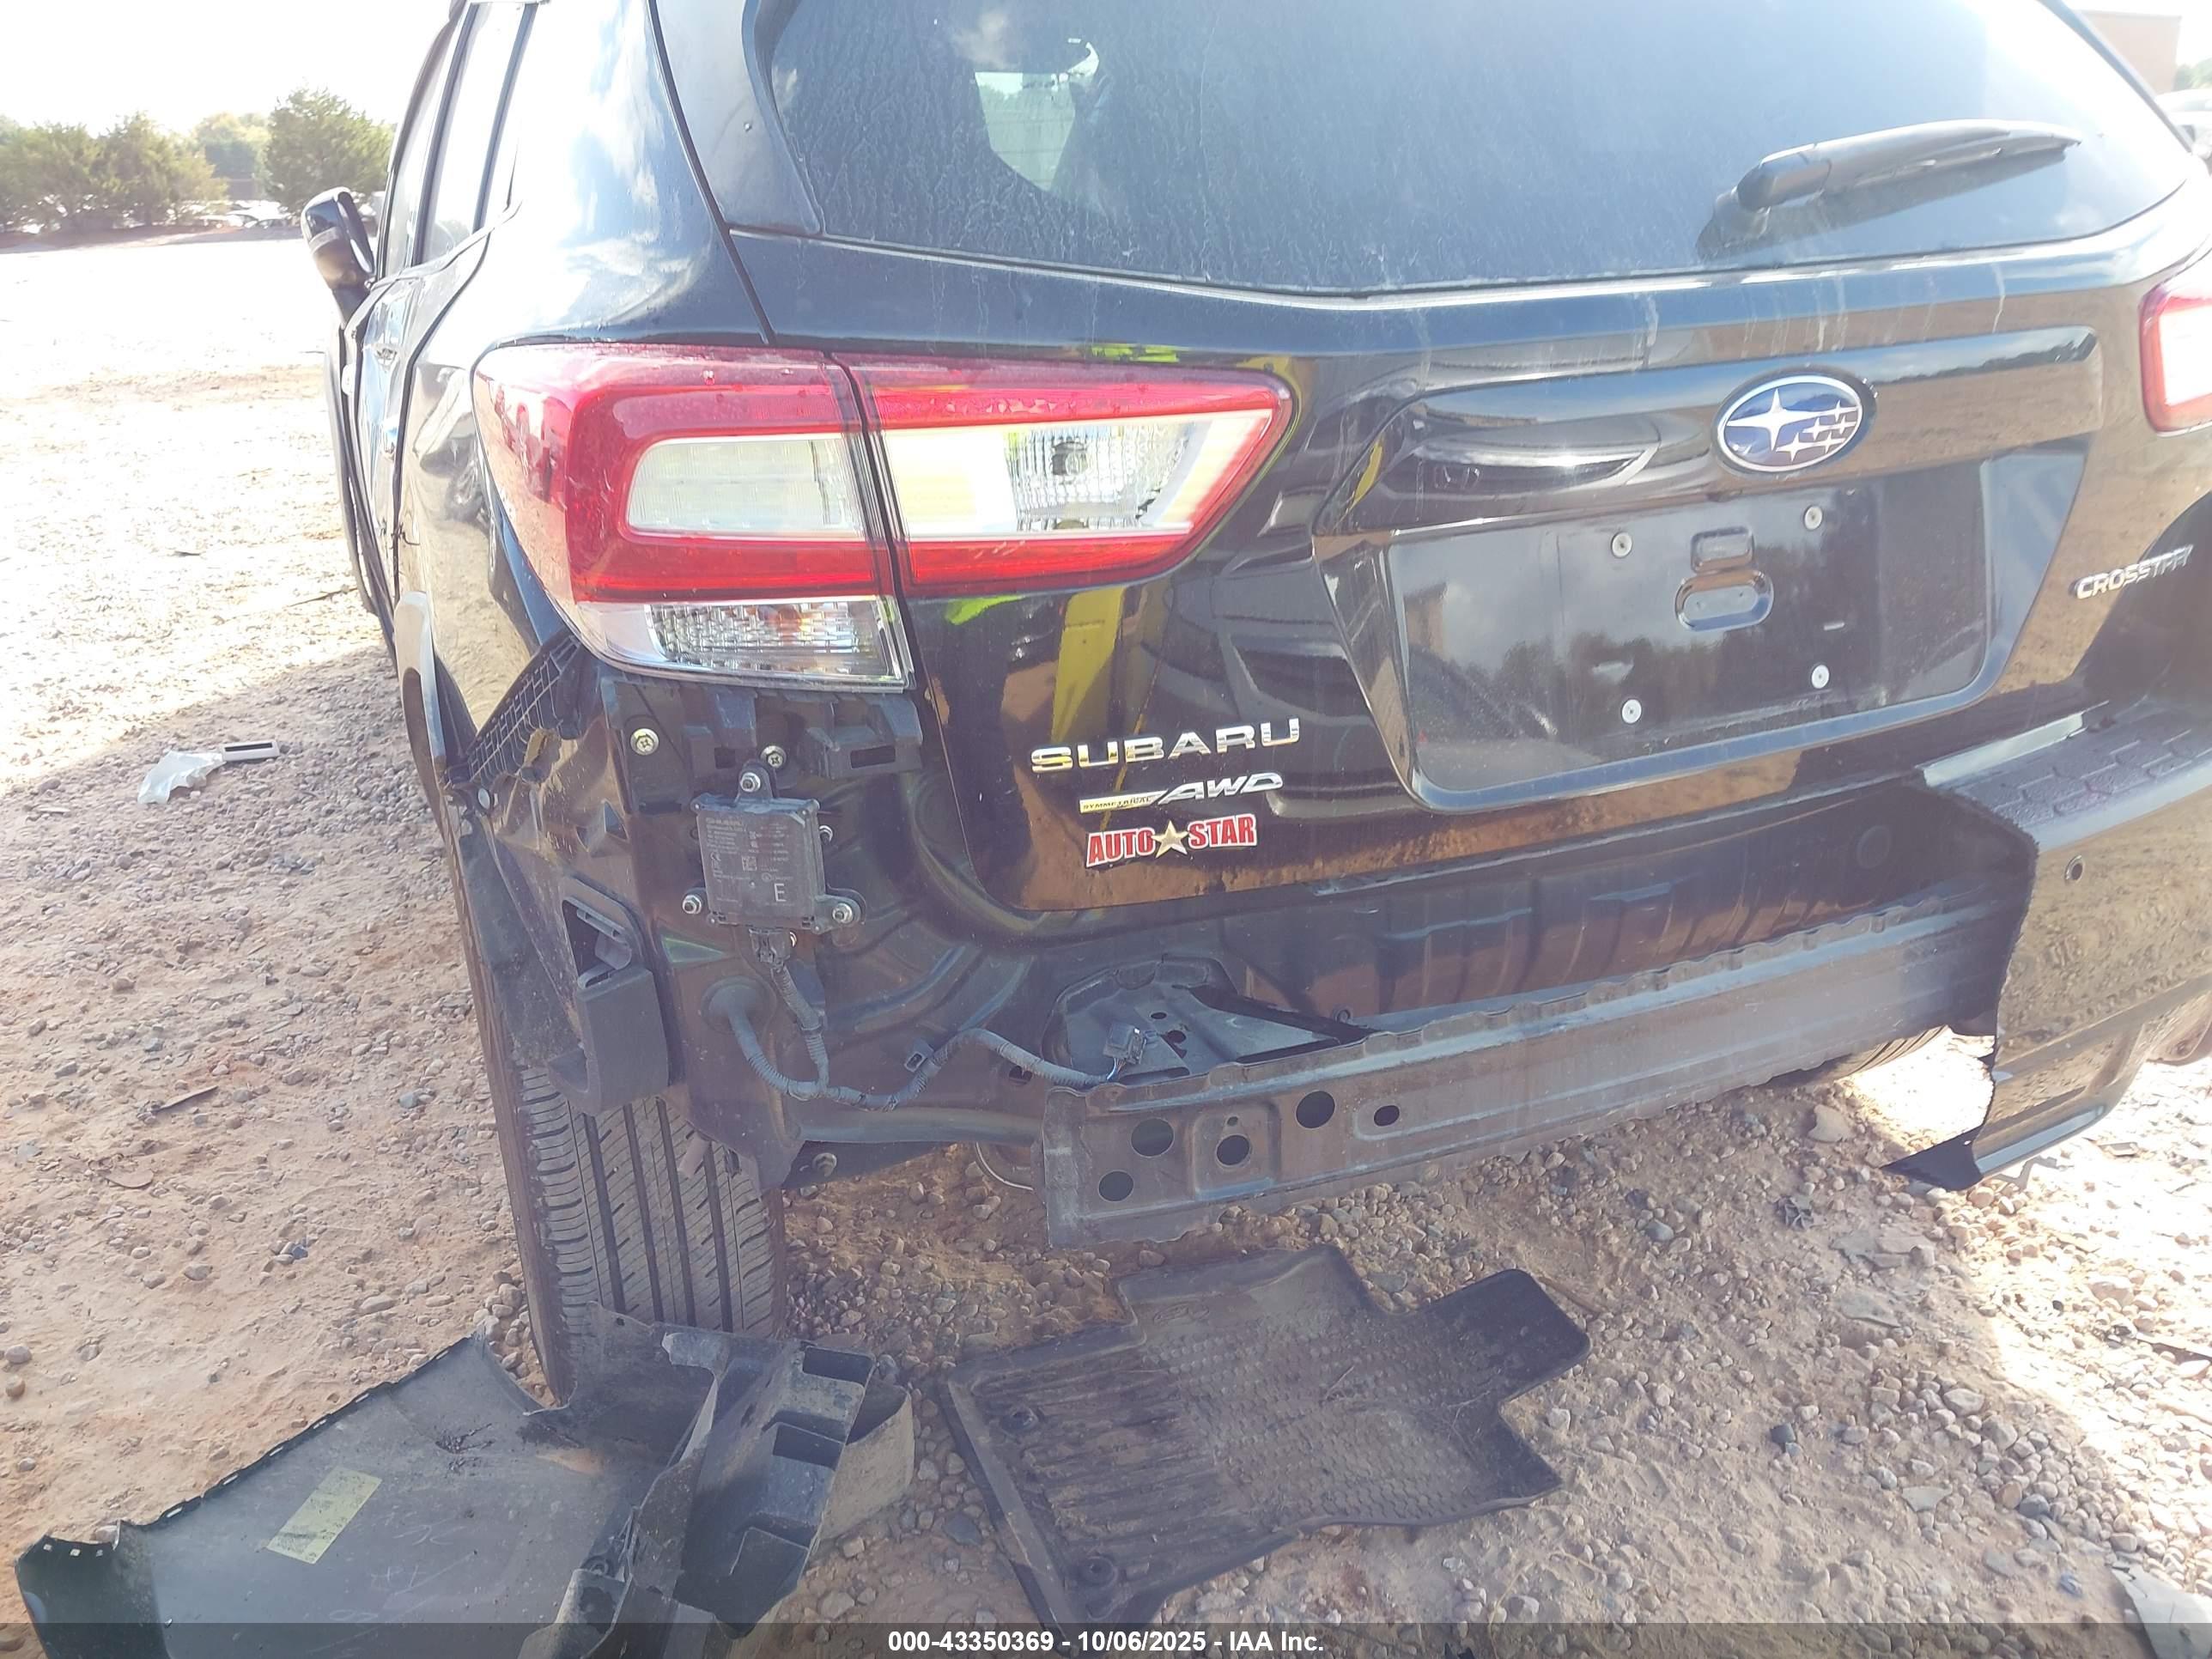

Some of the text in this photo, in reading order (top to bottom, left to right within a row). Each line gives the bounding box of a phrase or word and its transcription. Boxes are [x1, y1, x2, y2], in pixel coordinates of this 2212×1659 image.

[1030, 718, 1300, 773] SUBARU
[1158, 772, 1284, 805] AWD
[1086, 813, 1257, 867] AUTO STAR
[774, 883, 787, 902] E
